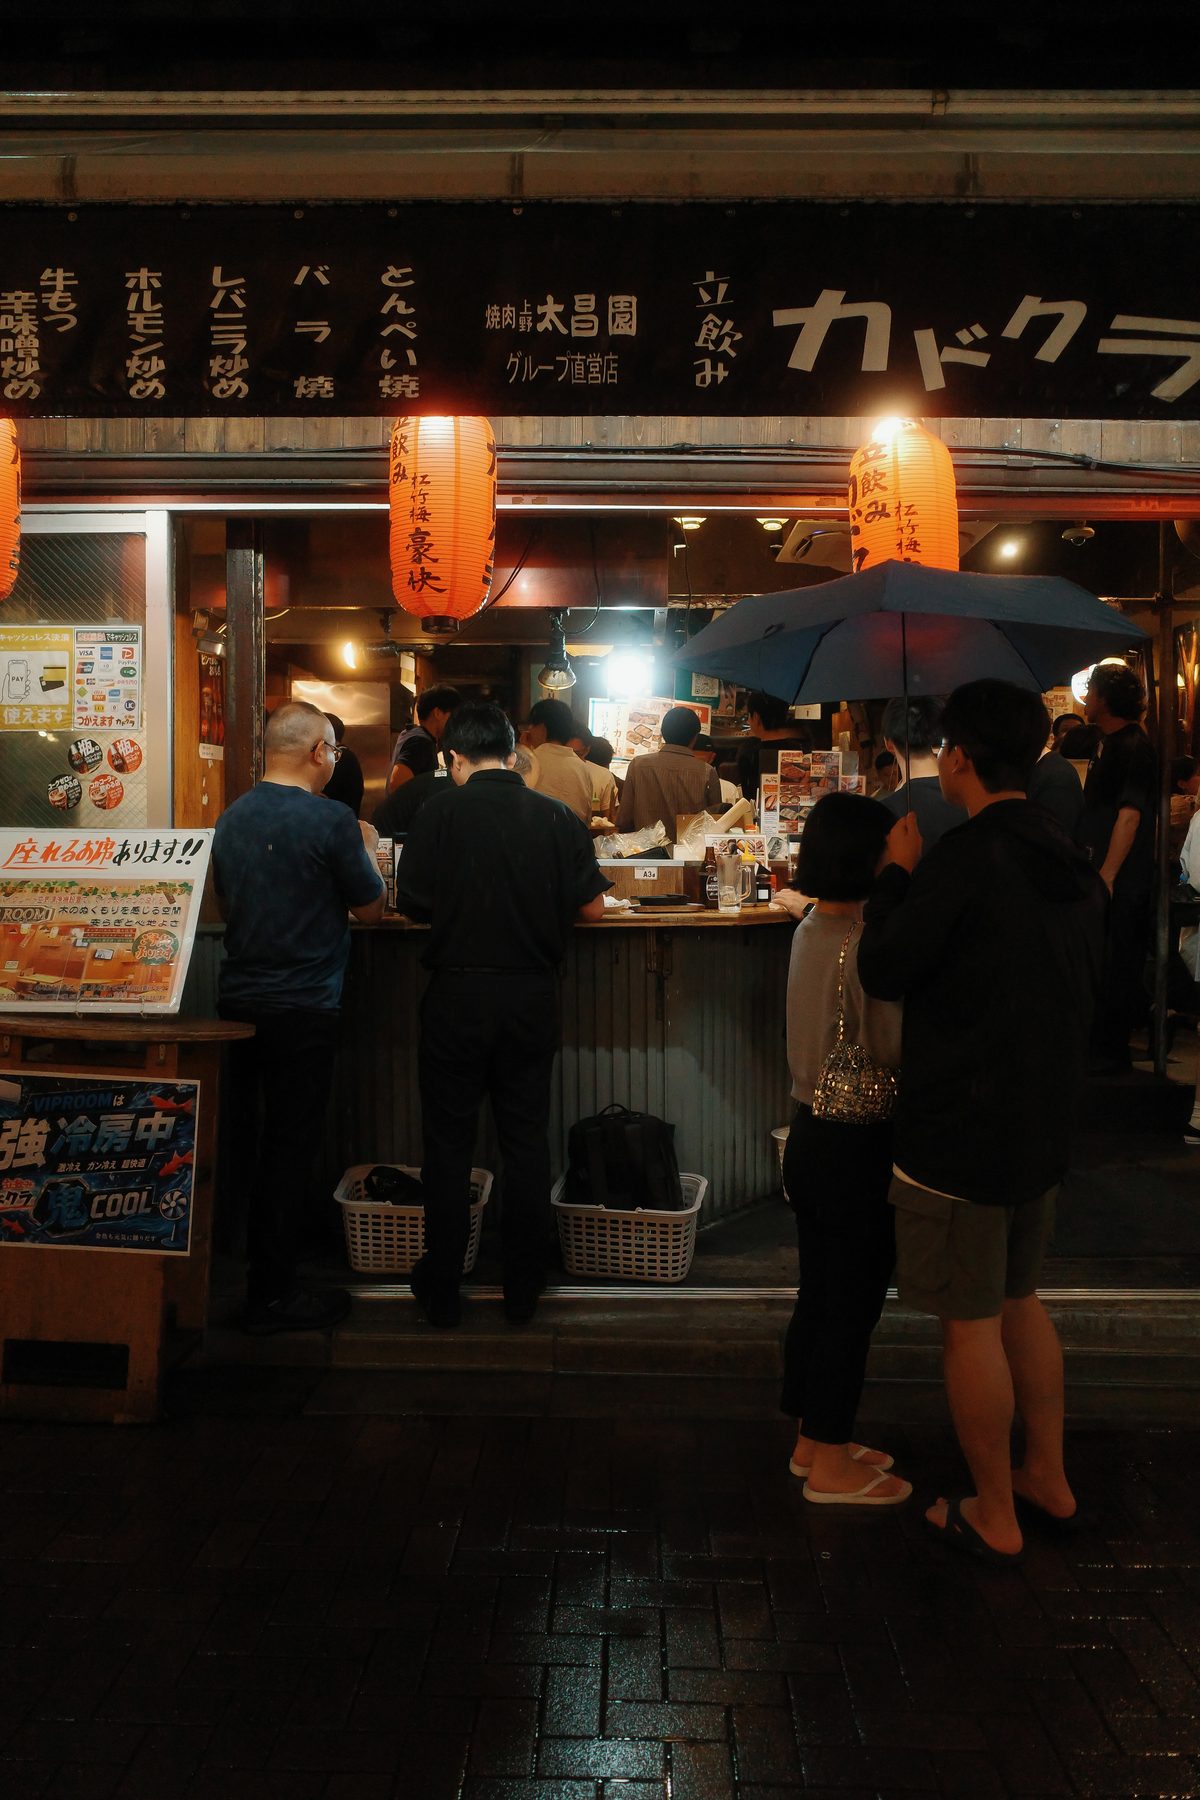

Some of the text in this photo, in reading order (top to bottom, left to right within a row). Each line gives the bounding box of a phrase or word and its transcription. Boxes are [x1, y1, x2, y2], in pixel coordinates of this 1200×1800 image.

[40, 268, 78, 332] 牛もつ
[125, 267, 166, 399] ホルモン炒め
[209, 266, 249, 398] レバニラ炒め
[379, 265, 419, 398] とんぺい焼
[692, 271, 743, 388] 立飲み
[0, 290, 41, 400] 辛味噌炒め
[506, 351, 619, 385] グループ直営店
[772, 289, 1200, 403] カドクラ
[858, 441, 891, 523] 立飲み
[894, 500, 922, 564] 松竹梅
[3, 706, 67, 725] 使えます
[77, 716, 114, 727] つかえます
[59, 906, 181, 915] 木のぬくもりを感じる空間
[90, 1190, 153, 1219] COOL
